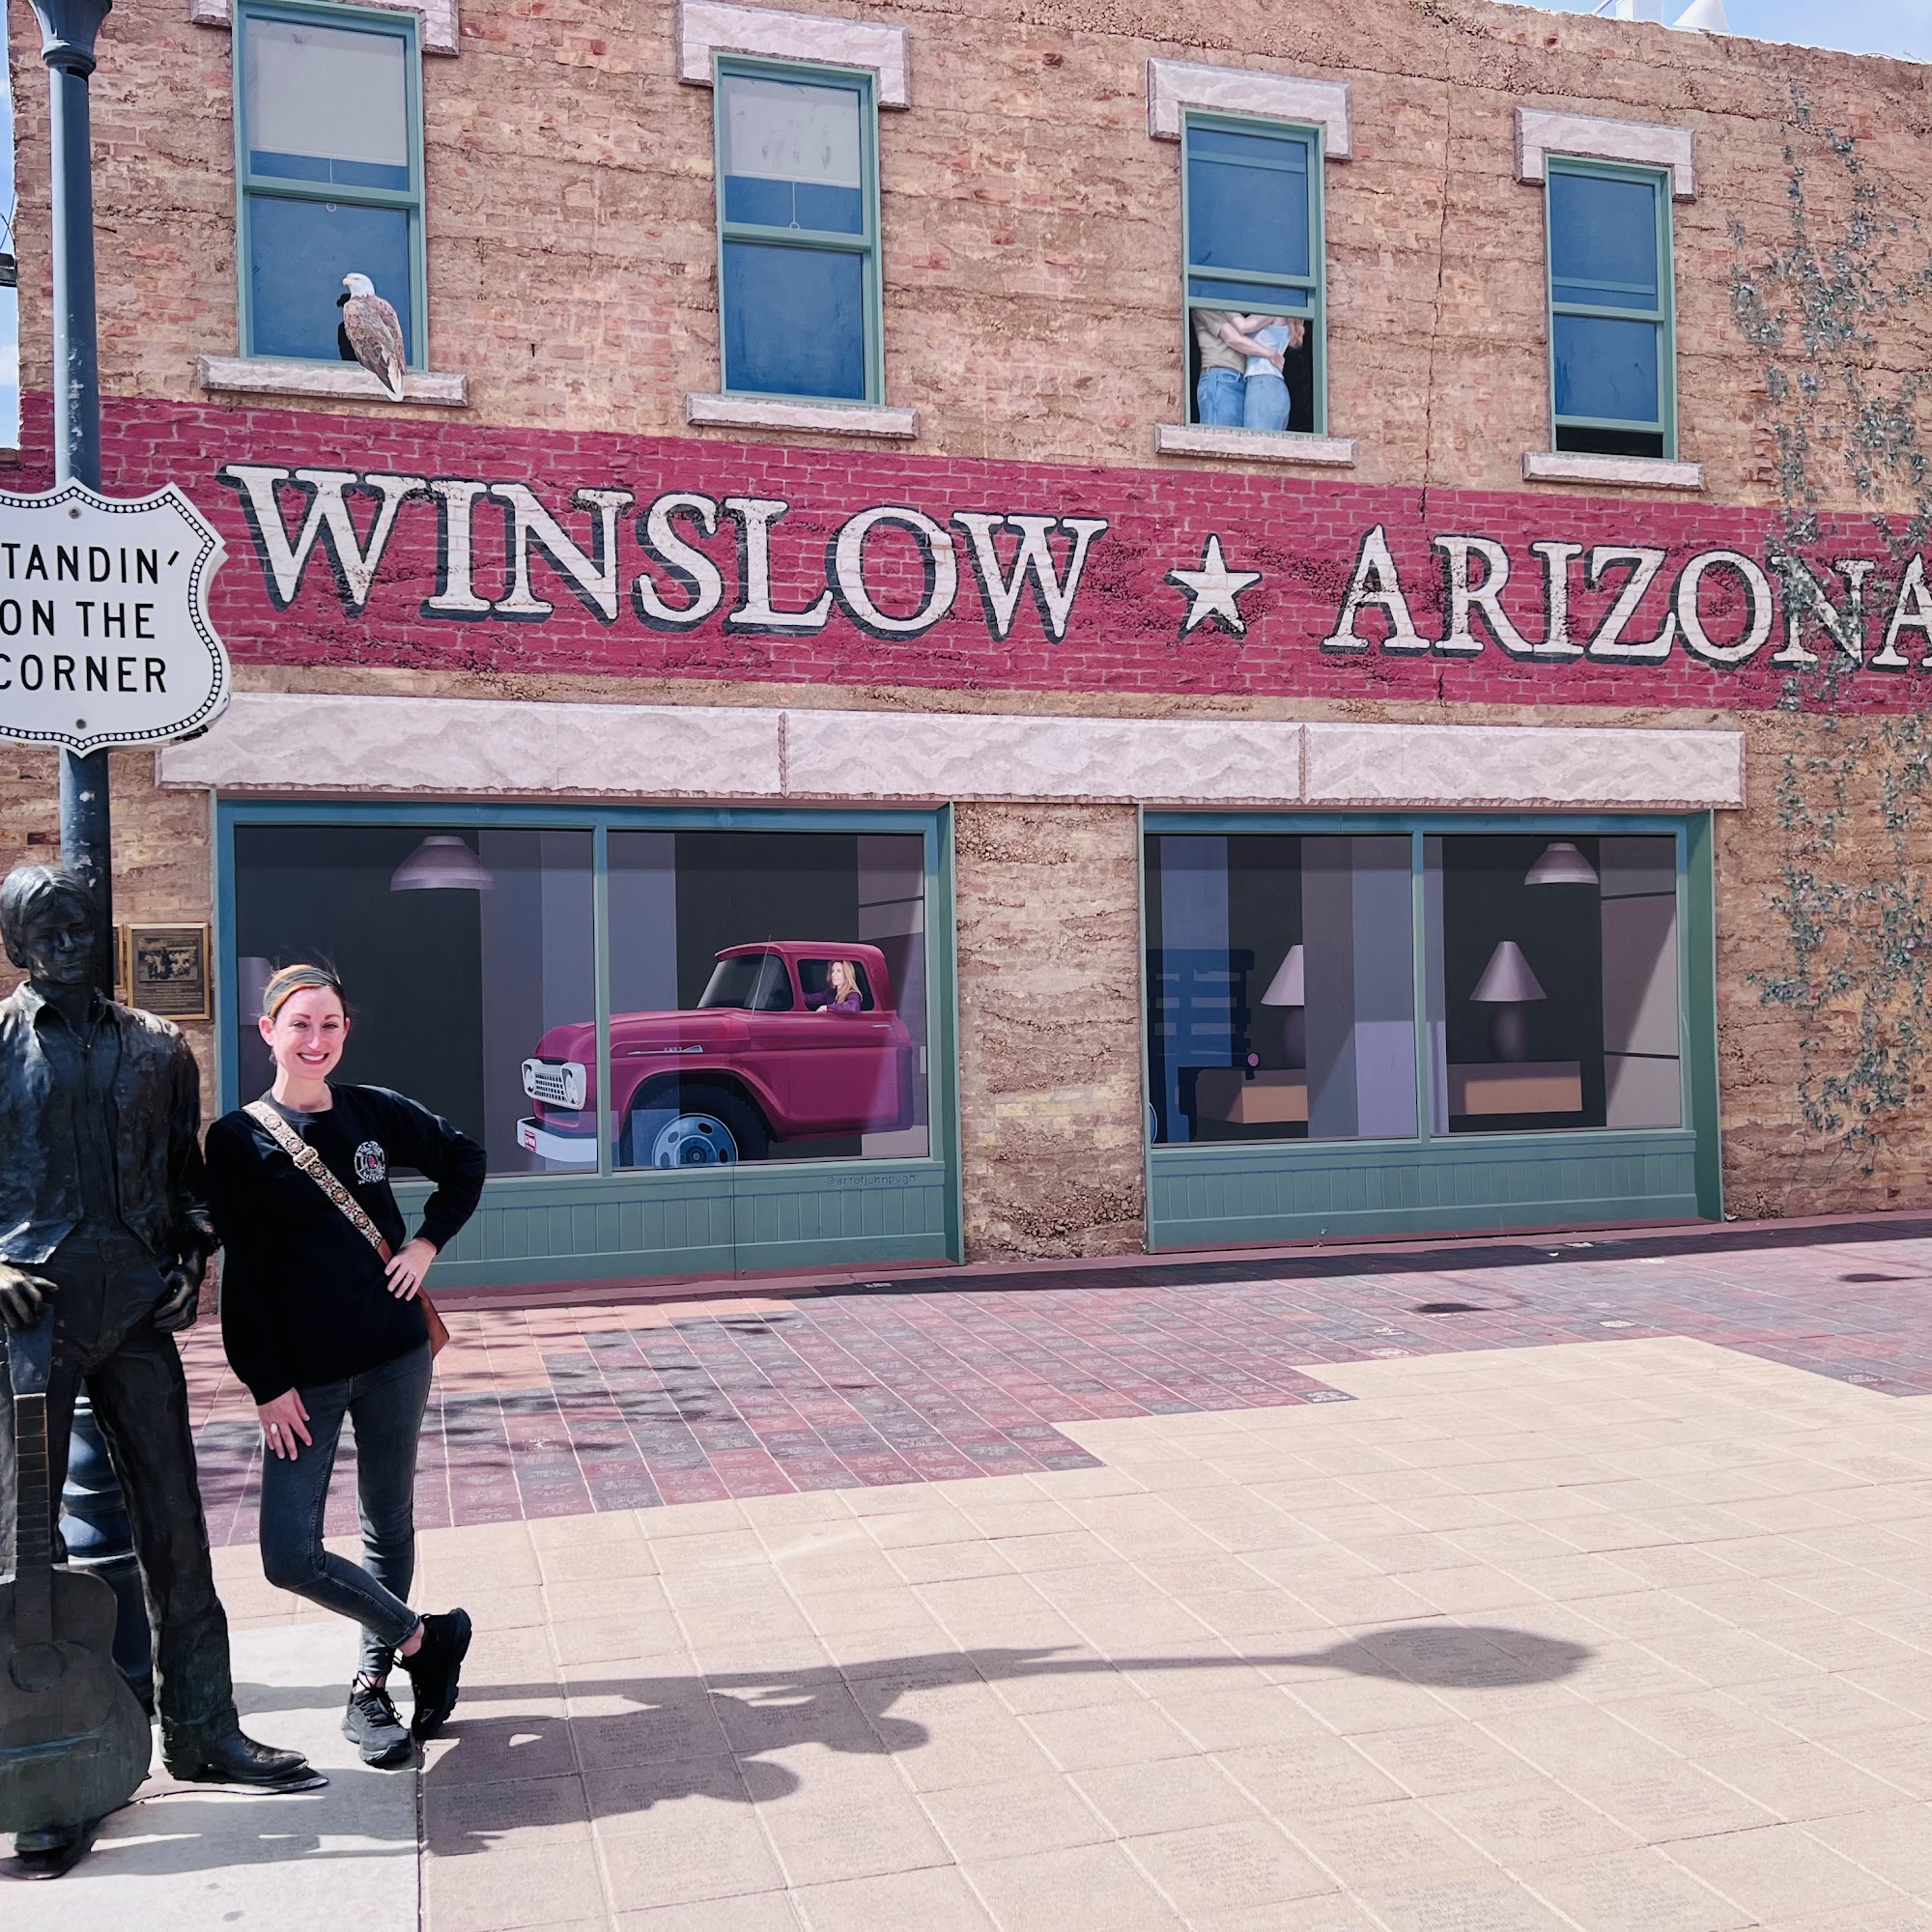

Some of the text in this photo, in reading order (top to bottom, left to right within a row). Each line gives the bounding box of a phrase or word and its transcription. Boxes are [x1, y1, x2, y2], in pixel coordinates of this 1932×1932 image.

[0, 599, 155, 639] ON THE
[220, 464, 1932, 672] WINSLOW ARIZONA
